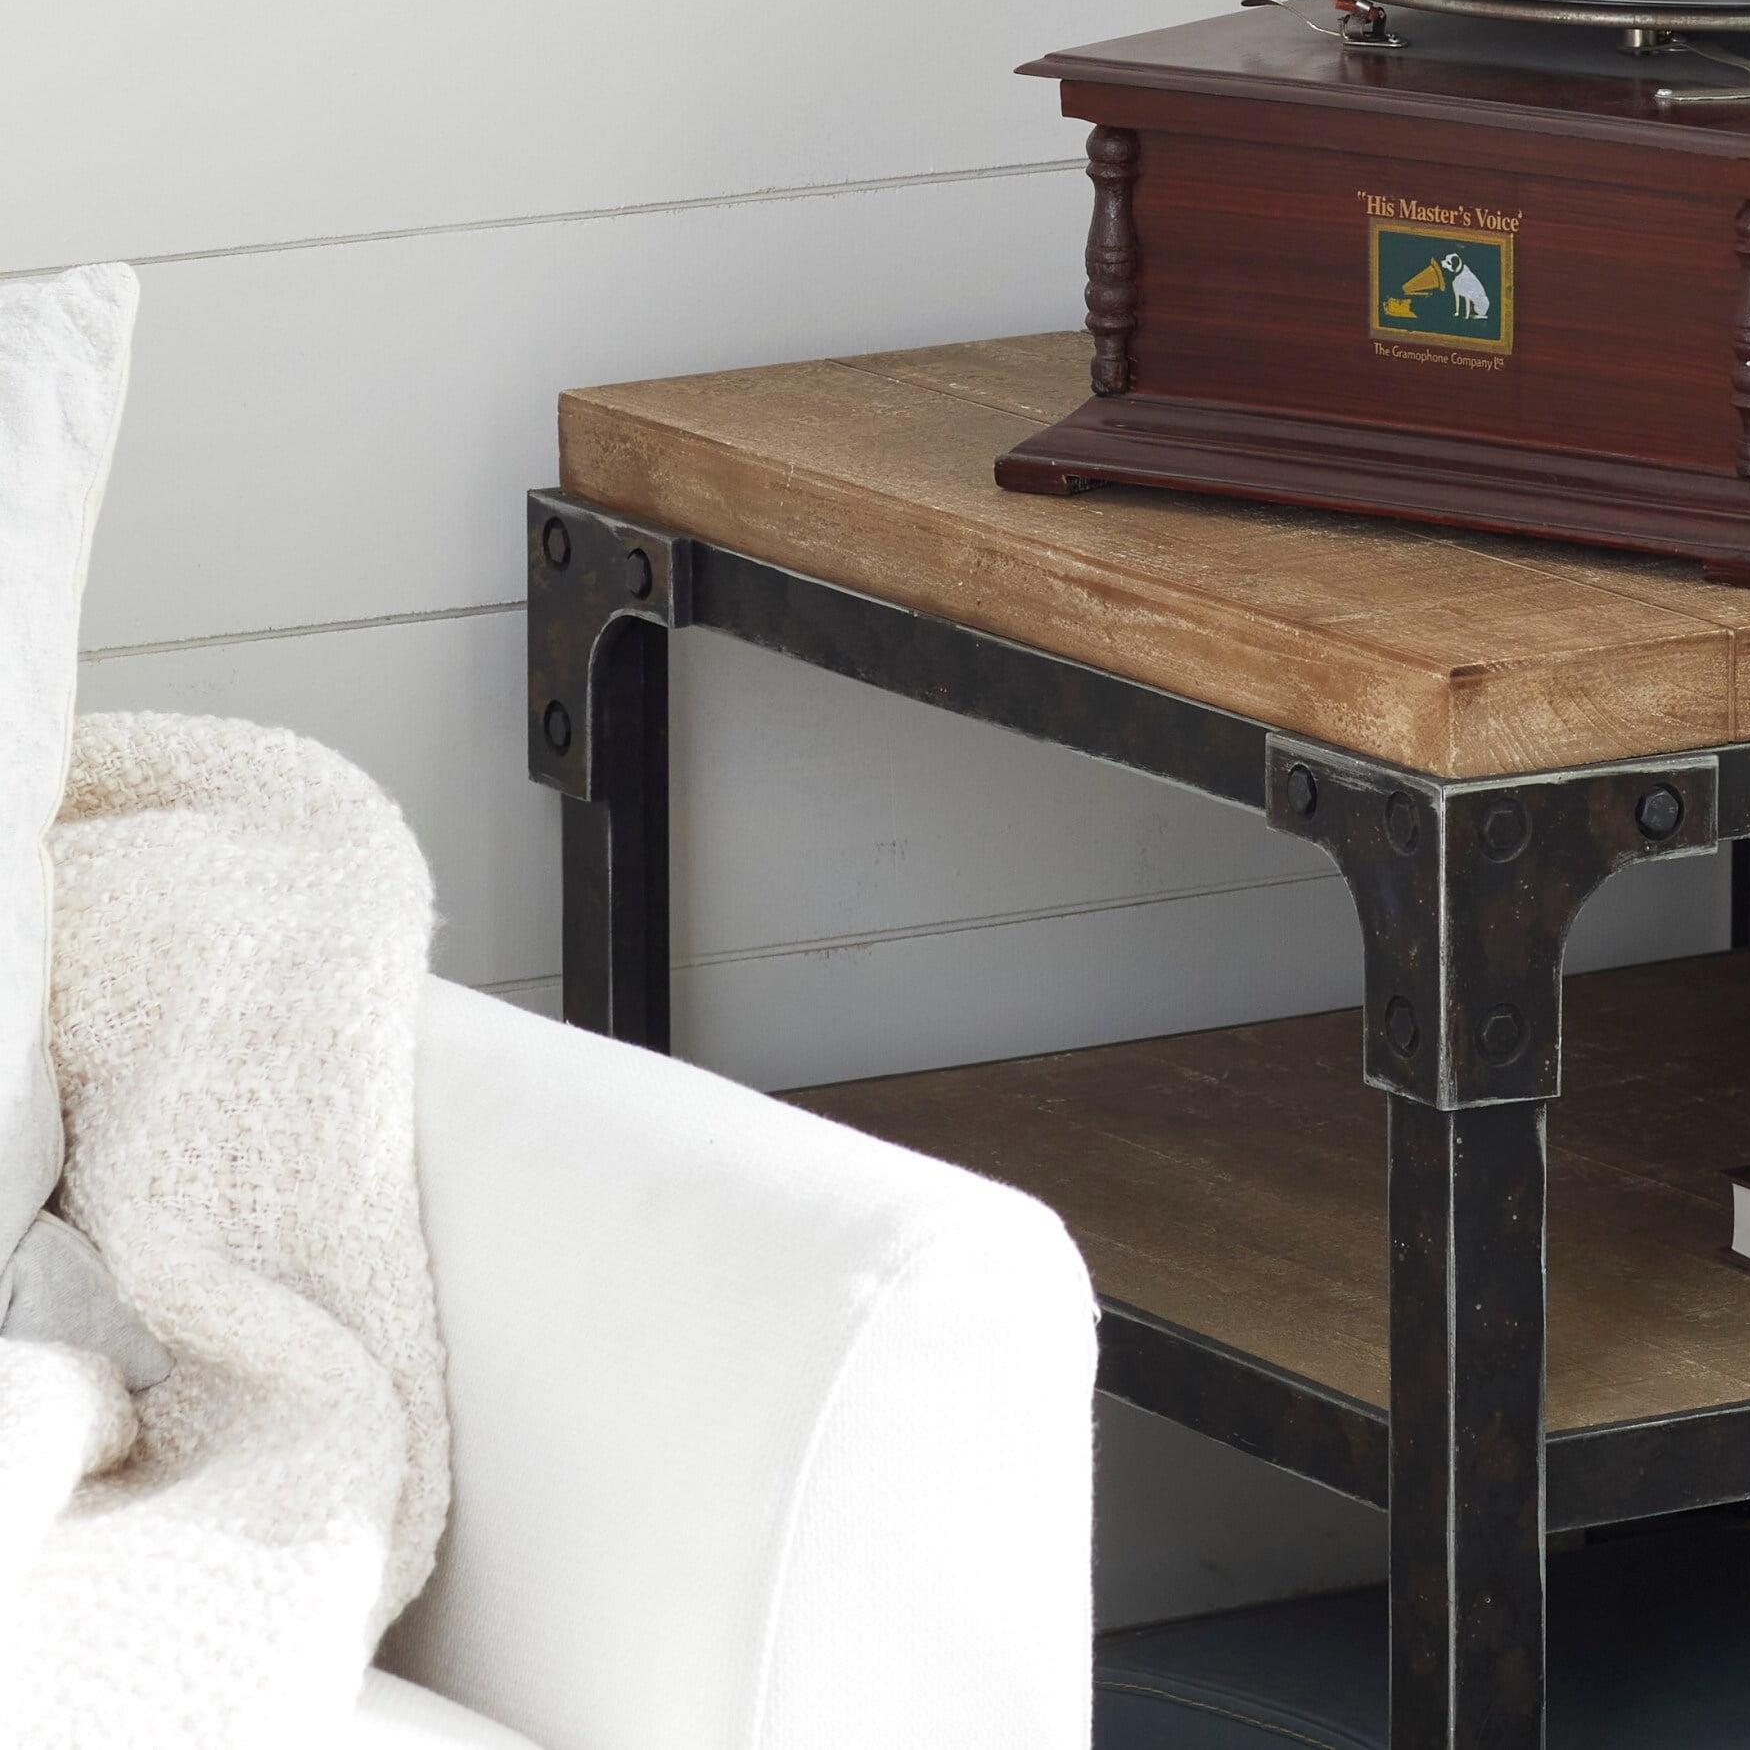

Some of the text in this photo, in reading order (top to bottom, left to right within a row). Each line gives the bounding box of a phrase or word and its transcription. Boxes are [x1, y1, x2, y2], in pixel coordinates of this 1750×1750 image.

[1399, 198, 1472, 227] Master's
[1373, 342, 1390, 357] The
[1392, 345, 1449, 364] Gramophone
[1450, 352, 1493, 371] Company
